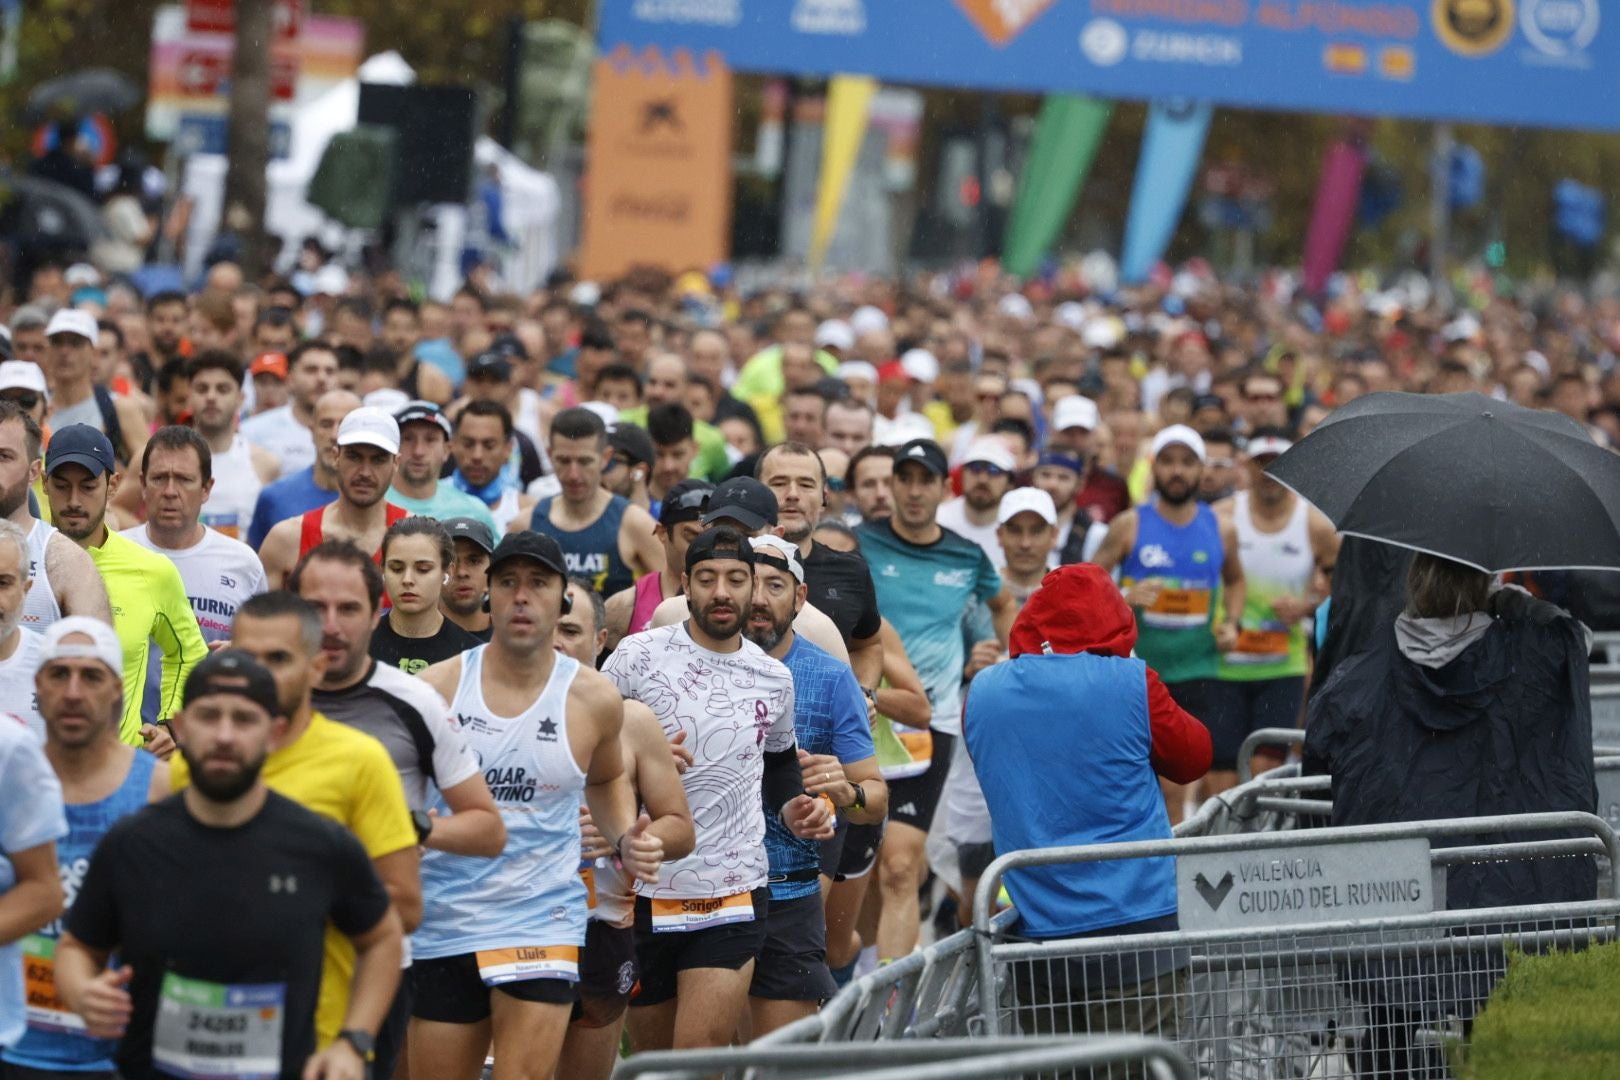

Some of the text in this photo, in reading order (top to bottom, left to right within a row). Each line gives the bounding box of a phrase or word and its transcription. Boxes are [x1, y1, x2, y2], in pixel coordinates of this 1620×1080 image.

[1134, 30, 1243, 66] ZURICH
[485, 768, 537, 786] OLAR es
[1240, 859, 1323, 882] VALENCIA
[1239, 879, 1421, 914] CIUDAD DEL RUNNING
